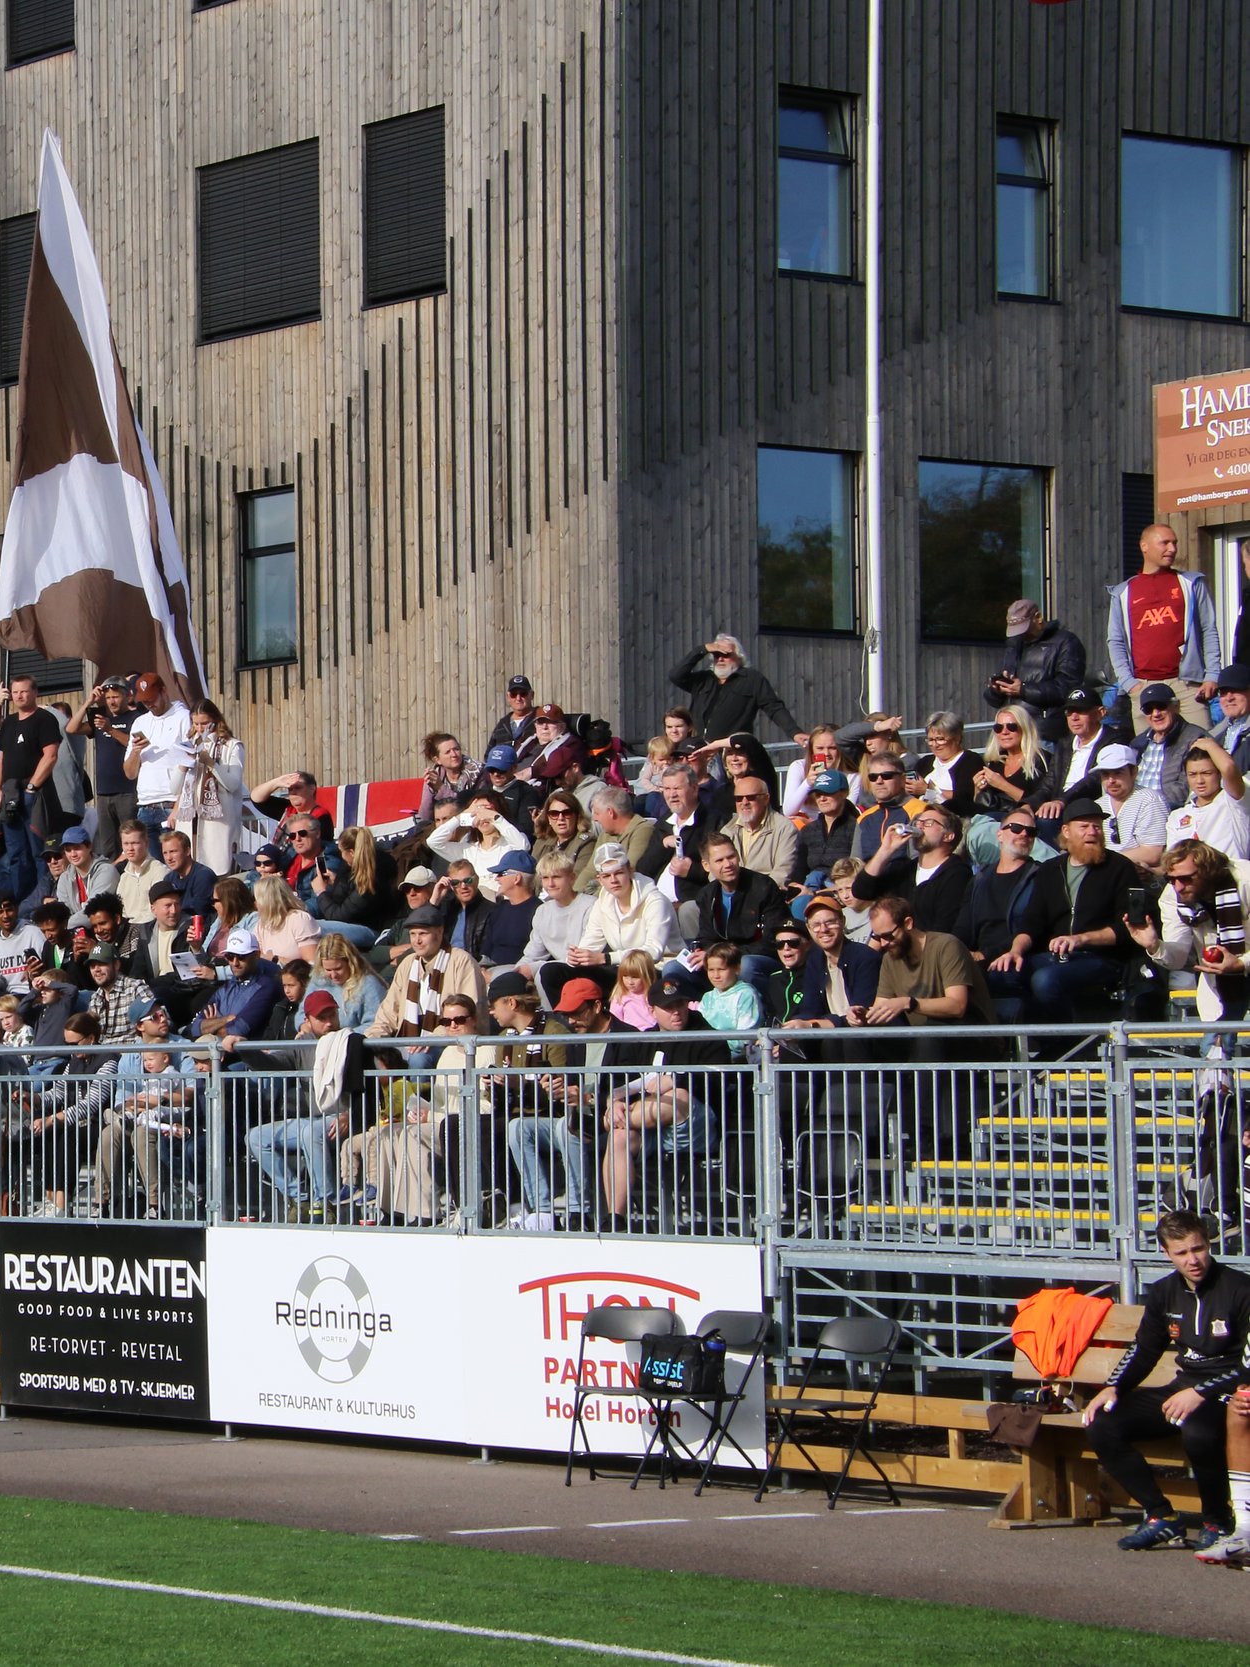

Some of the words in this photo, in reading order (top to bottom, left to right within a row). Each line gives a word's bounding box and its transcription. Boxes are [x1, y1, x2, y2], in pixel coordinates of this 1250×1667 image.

[1137, 606, 1179, 630] AXA
[4, 1253, 206, 1299] RESTAURANTEN
[18, 1303, 53, 1316] GOOD
[59, 1305, 93, 1318] FOOD
[100, 1307, 106, 1318] &
[113, 1308, 140, 1321] LIVE
[147, 1310, 194, 1323] SPORTS
[275, 1301, 392, 1338] Redninga
[30, 1336, 106, 1356] RE-TORVET
[122, 1342, 182, 1362] REVETAL
[19, 1373, 79, 1391] SPORTSPUB
[83, 1377, 106, 1393] MED
[110, 1379, 117, 1394] 8
[258, 1393, 333, 1413] RESTAURANT
[336, 1399, 344, 1413] &
[346, 1400, 416, 1419] KULTURHUS
